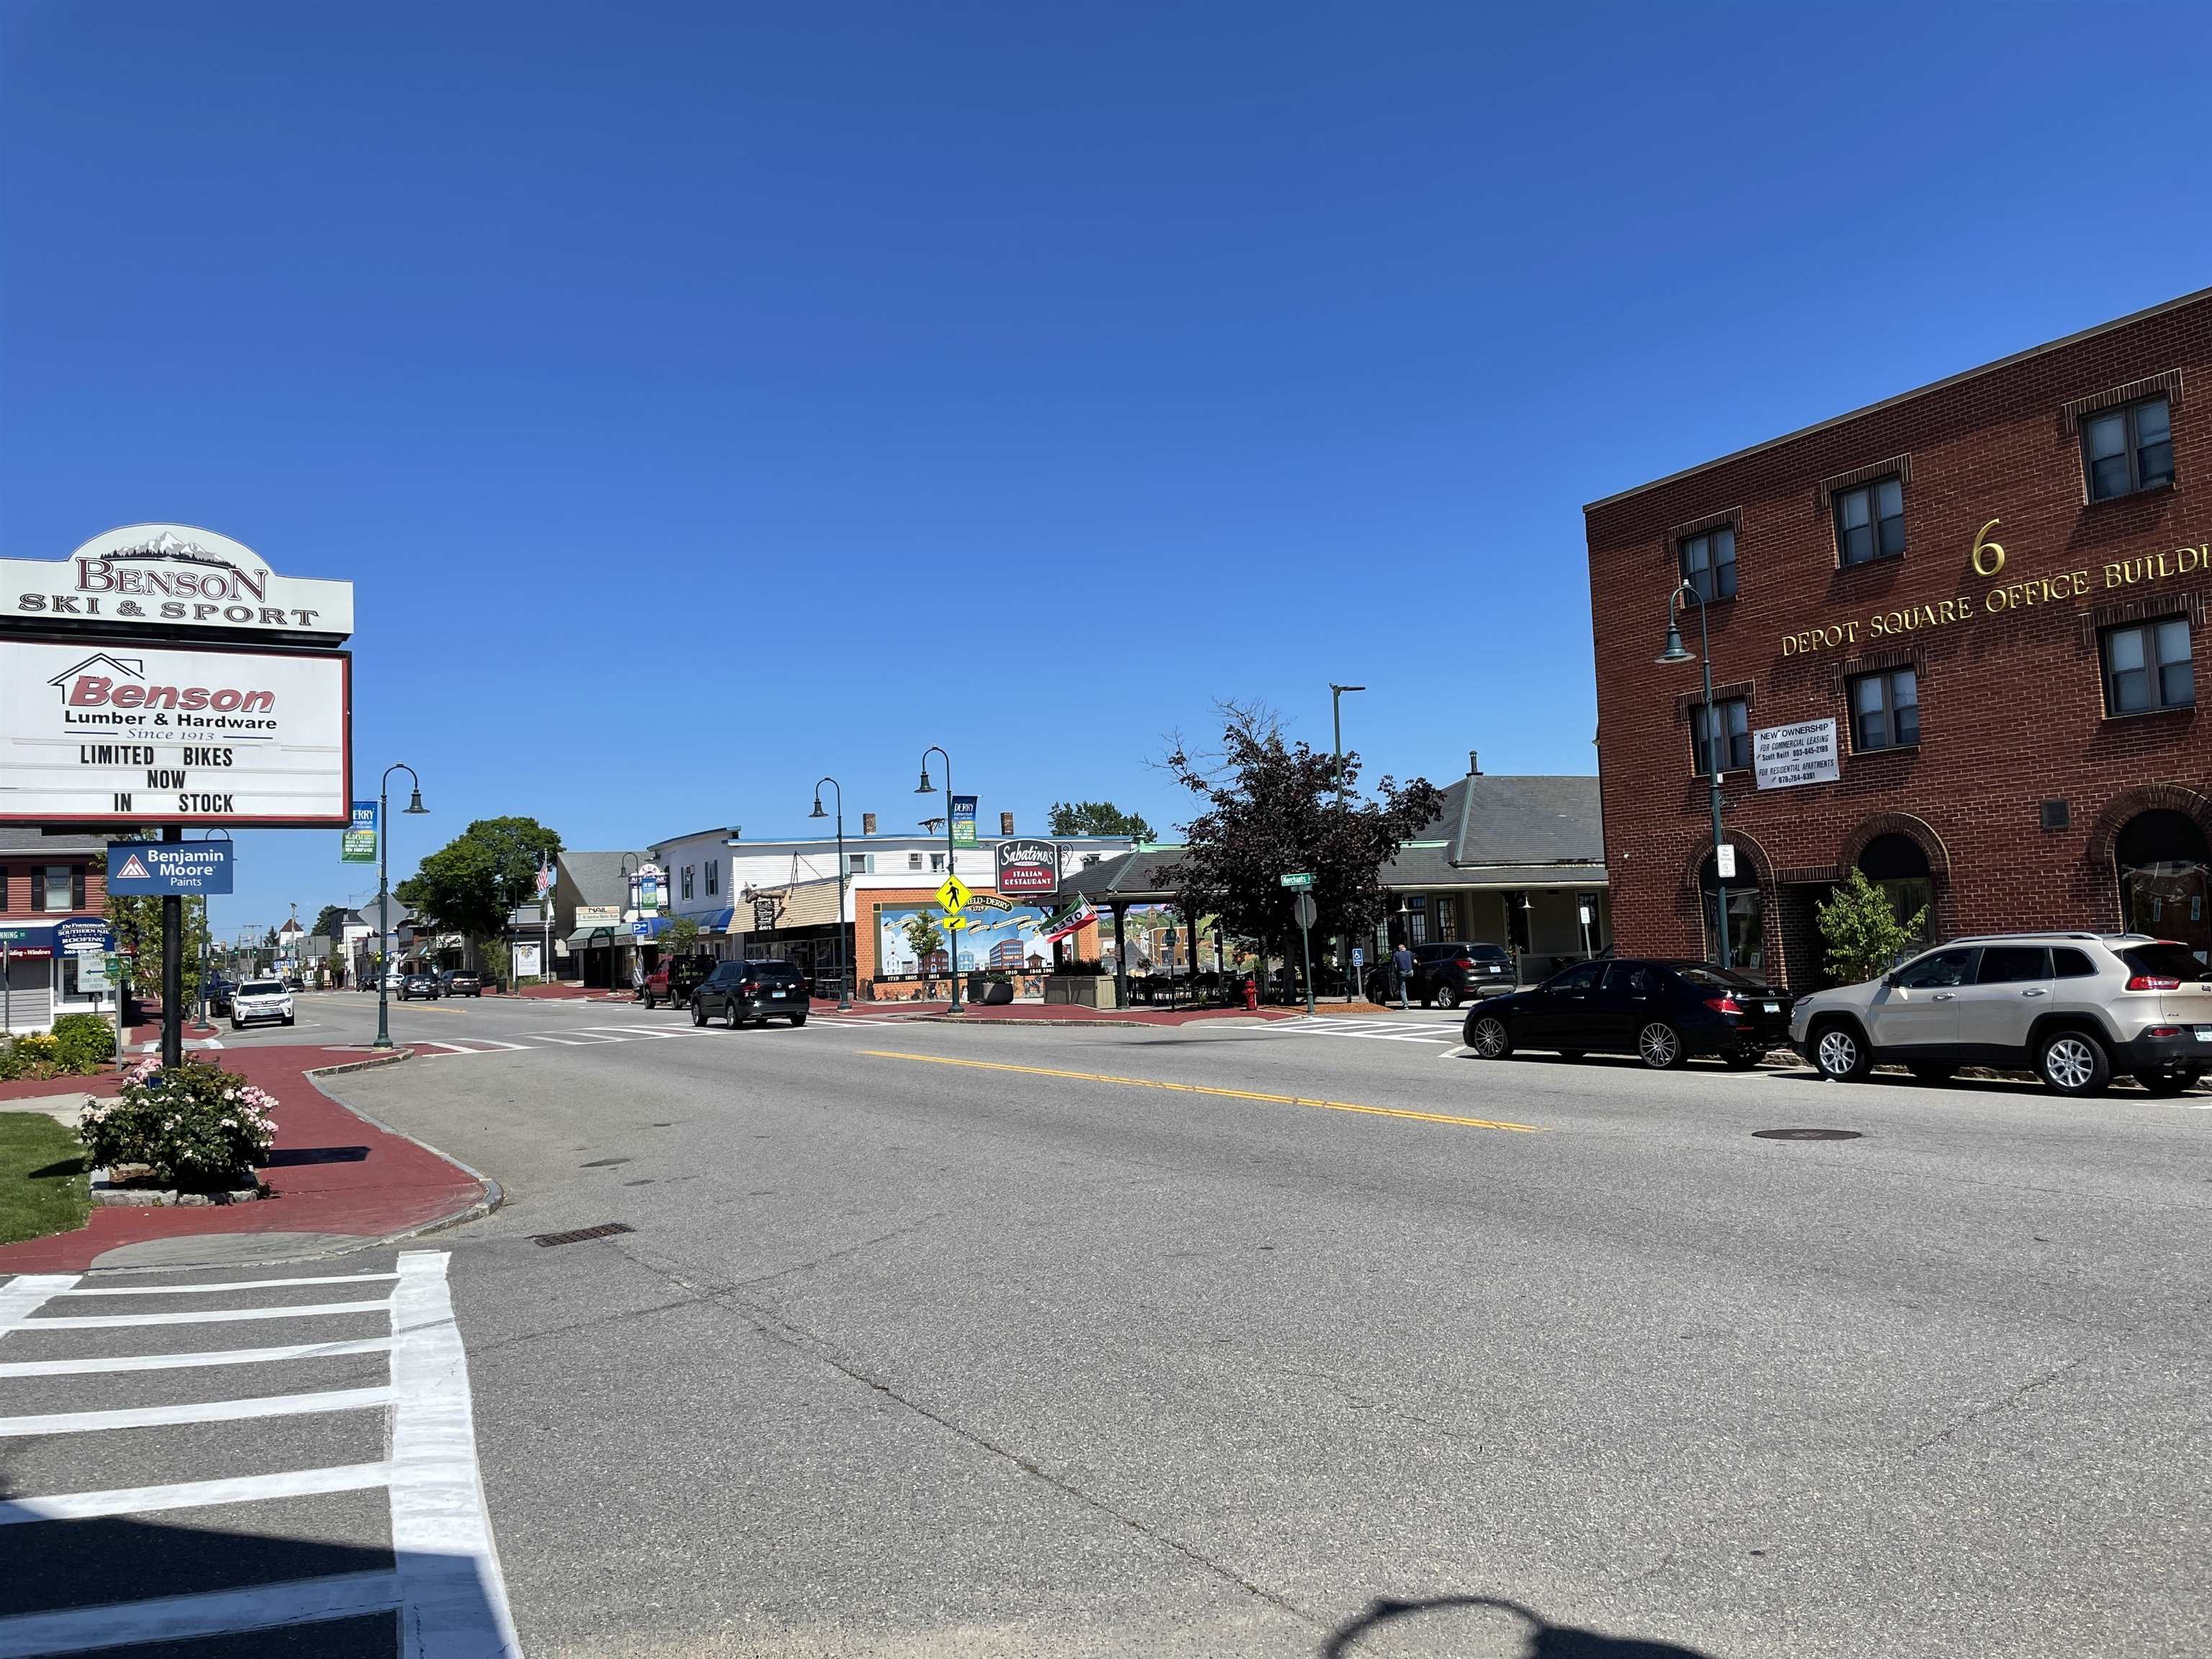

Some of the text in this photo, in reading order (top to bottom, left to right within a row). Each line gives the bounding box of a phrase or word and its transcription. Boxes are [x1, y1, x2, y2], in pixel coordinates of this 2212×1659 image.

[1972, 518, 2005, 577] 6
[76, 557, 268, 603] BENSON
[1781, 543, 2212, 656] DEPOT SQUARE OFFICE BUILDI
[18, 593, 319, 626] SKI & SPORT
[68, 675, 276, 714] Benson
[65, 710, 277, 729] Lumber & Hardware
[127, 728, 214, 740] Since 1913
[1761, 723, 1829, 740] NEW OWNERSHIP
[1761, 734, 1829, 752] FOR COMMERCIAL LEASING
[81, 745, 233, 766] LIMITED BIKES
[1762, 751, 1775, 761] Scott
[1770, 764, 1800, 775] RESIDENTIAL
[1802, 759, 1834, 770] APARTMENTS
[147, 770, 186, 789] NOW
[114, 793, 234, 812] IN STOCK
[955, 803, 974, 811] DERRY
[353, 809, 374, 819] ERRY
[148, 848, 225, 863] Benjamin
[1001, 842, 1053, 866] Sabatino's
[160, 863, 214, 876] Moore
[170, 877, 202, 887] Paints
[1282, 876, 1306, 884] Merchants
